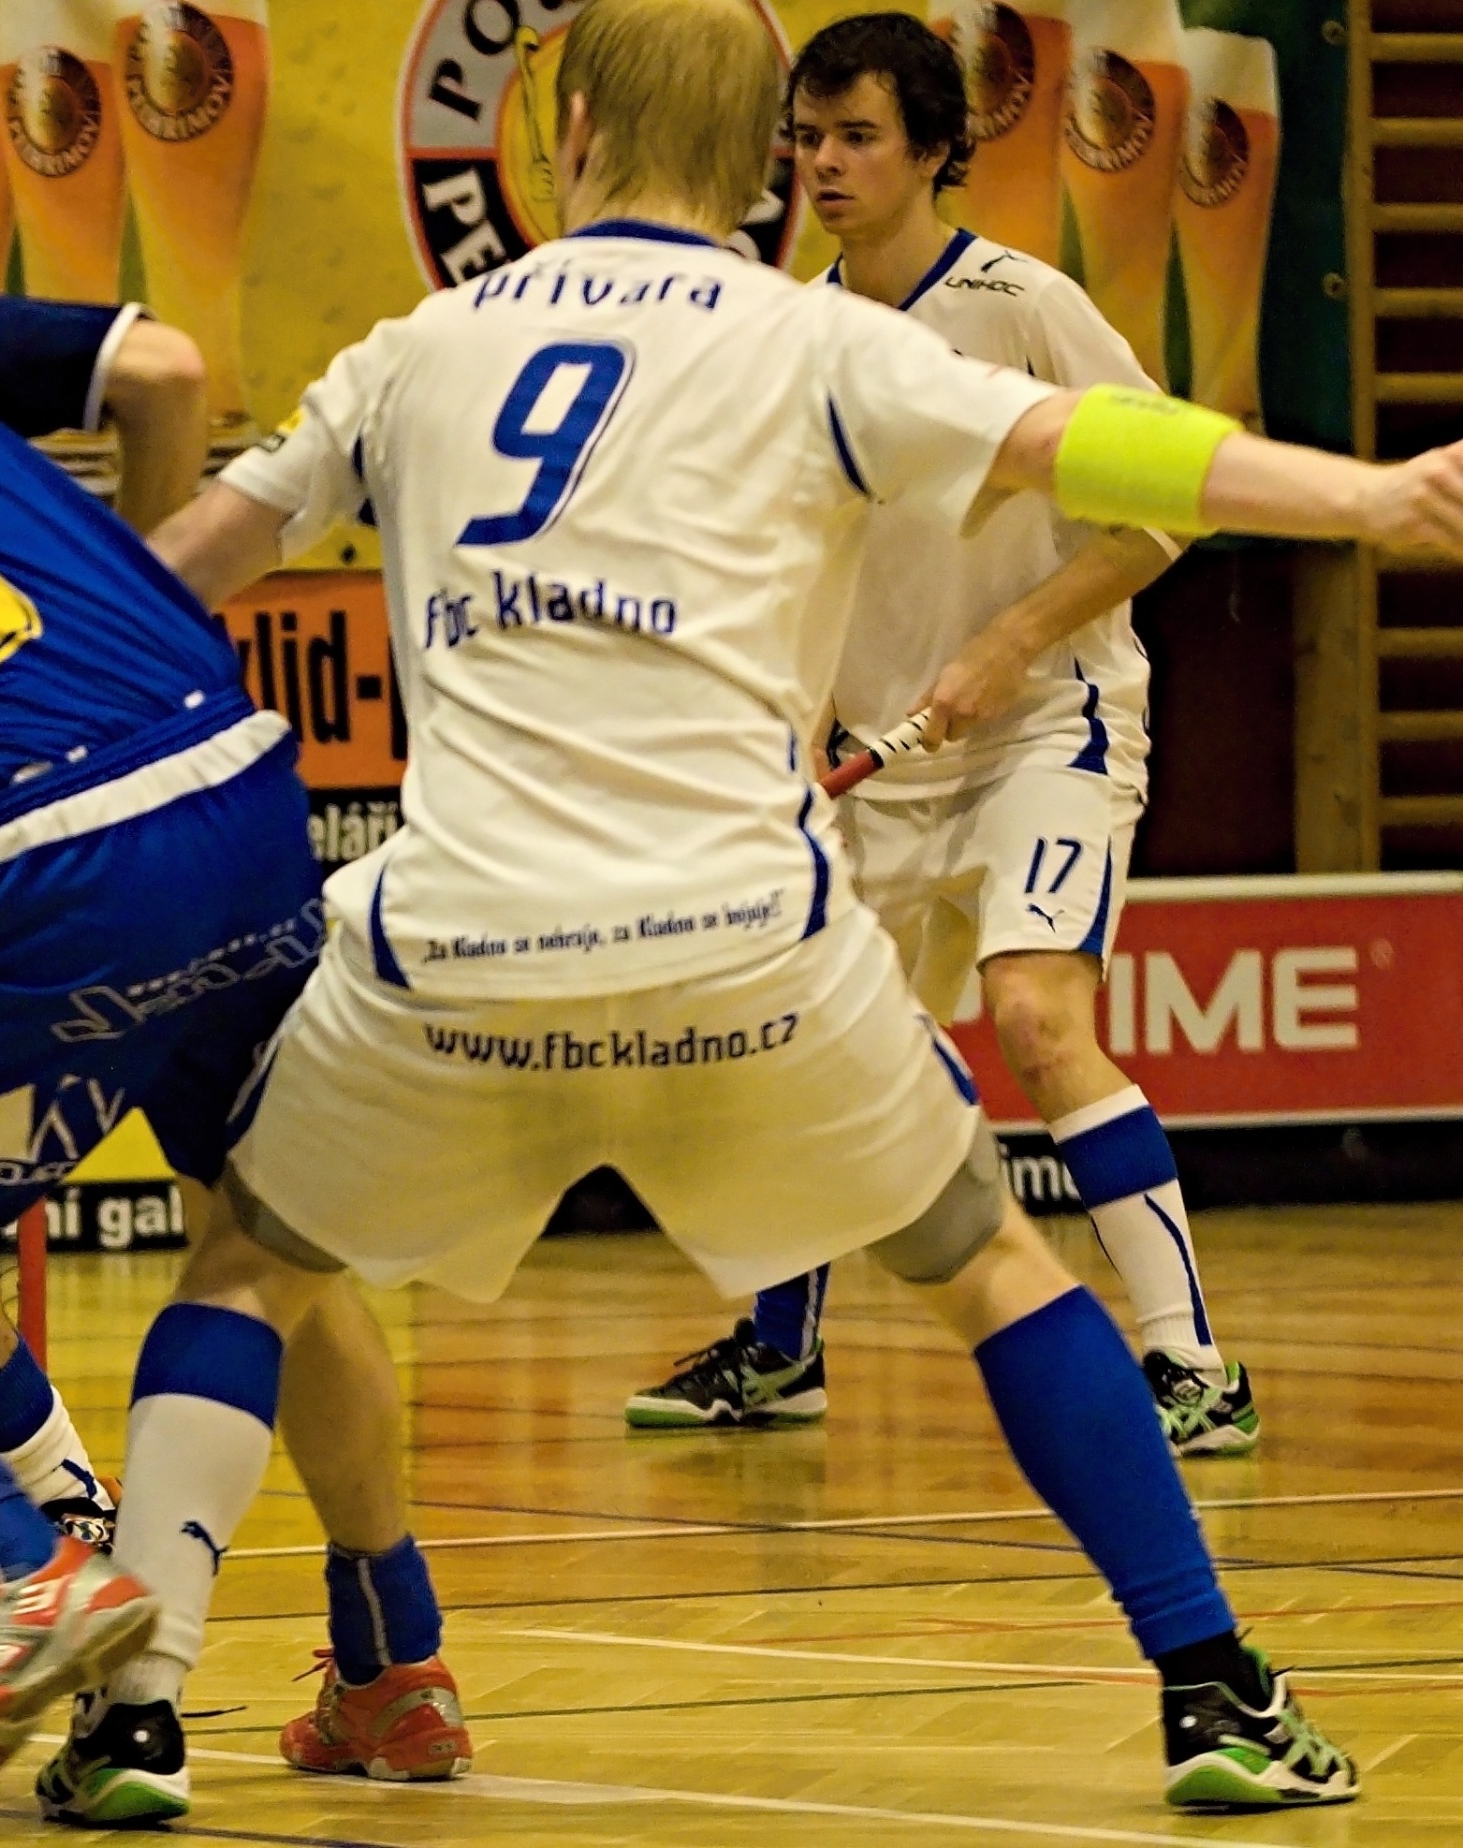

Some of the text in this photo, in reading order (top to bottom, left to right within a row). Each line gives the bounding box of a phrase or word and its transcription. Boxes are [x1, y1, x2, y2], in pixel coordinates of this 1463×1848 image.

[945, 276, 1025, 297] UNIHOC
[456, 340, 636, 546] 9
[493, 568, 678, 634] kladno
[212, 609, 408, 761] lid-
[1024, 838, 1082, 894] 17
[424, 1010, 800, 1072] www.fbckladno.cz
